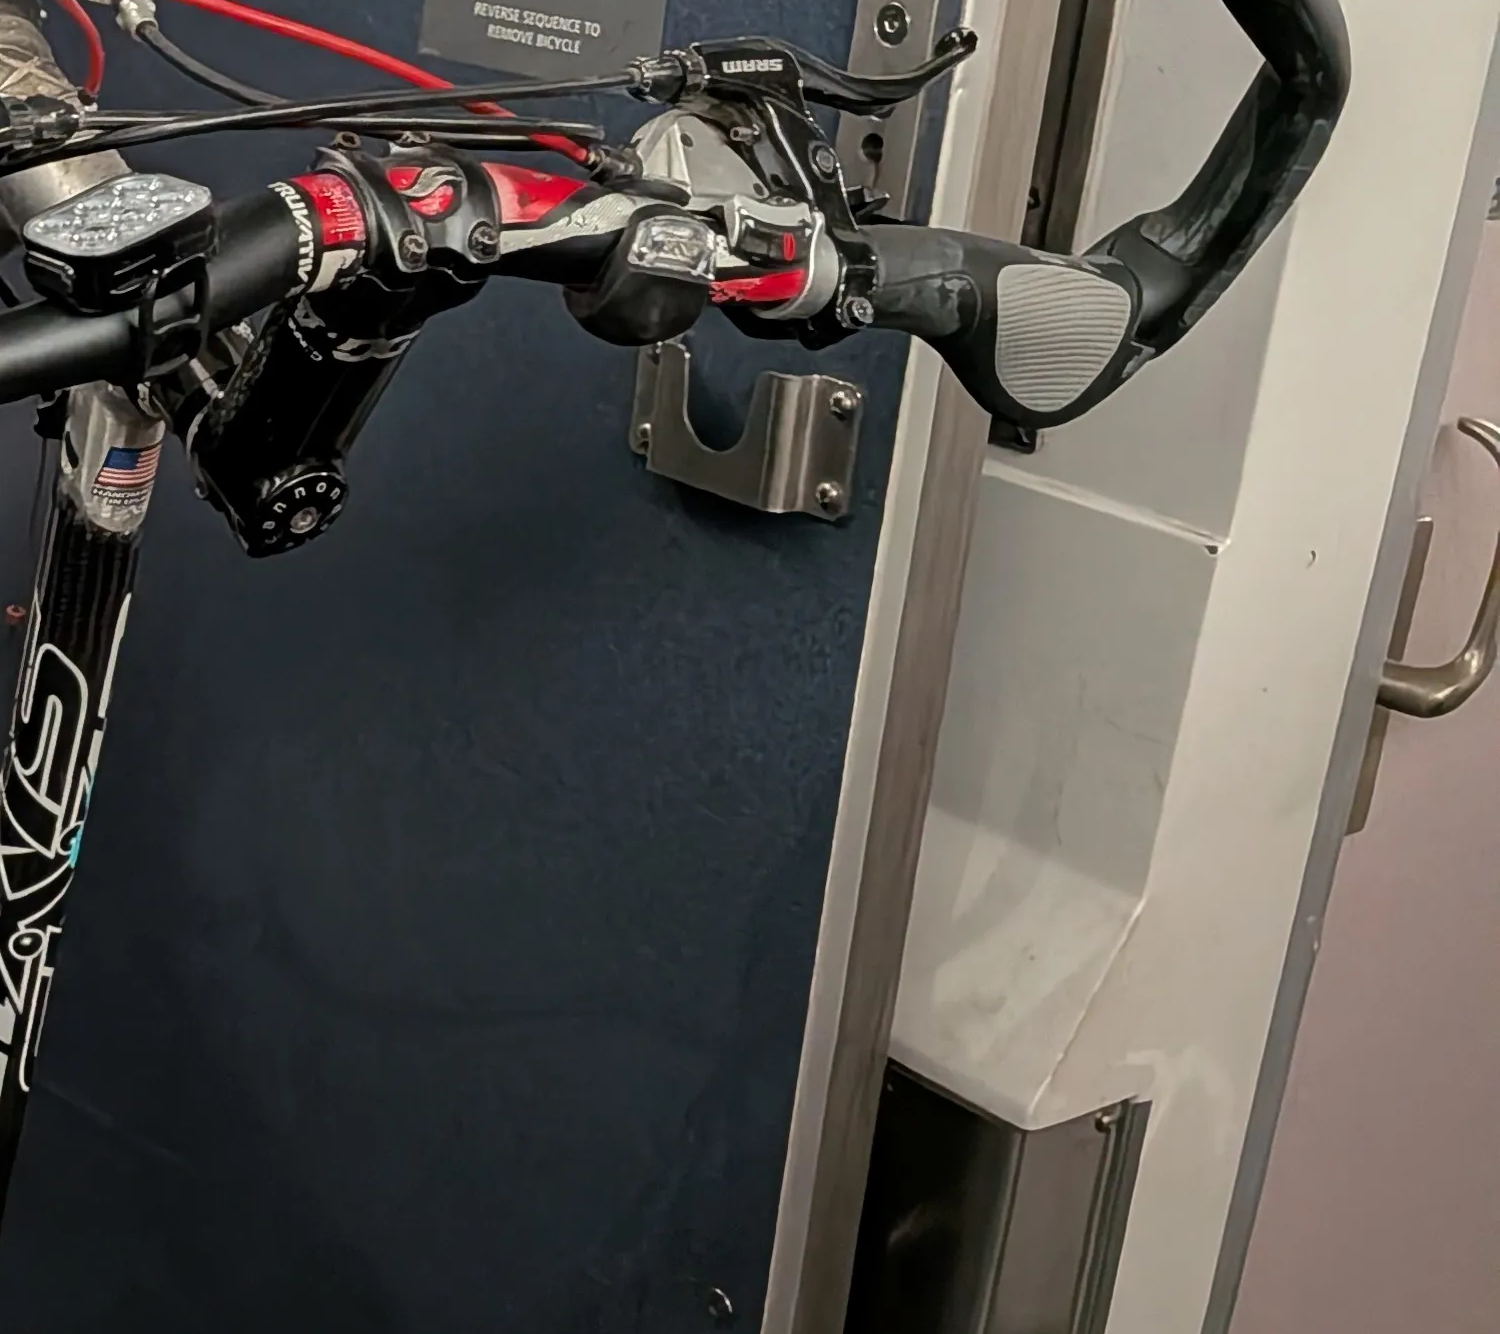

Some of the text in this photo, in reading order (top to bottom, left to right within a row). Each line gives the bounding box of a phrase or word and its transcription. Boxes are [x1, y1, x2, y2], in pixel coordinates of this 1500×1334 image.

[473, 1, 601, 37] REVERSE SEQUENCE TO
[487, 23, 582, 55] REMOVE BICYCLE
[722, 58, 783, 73] SRAM
